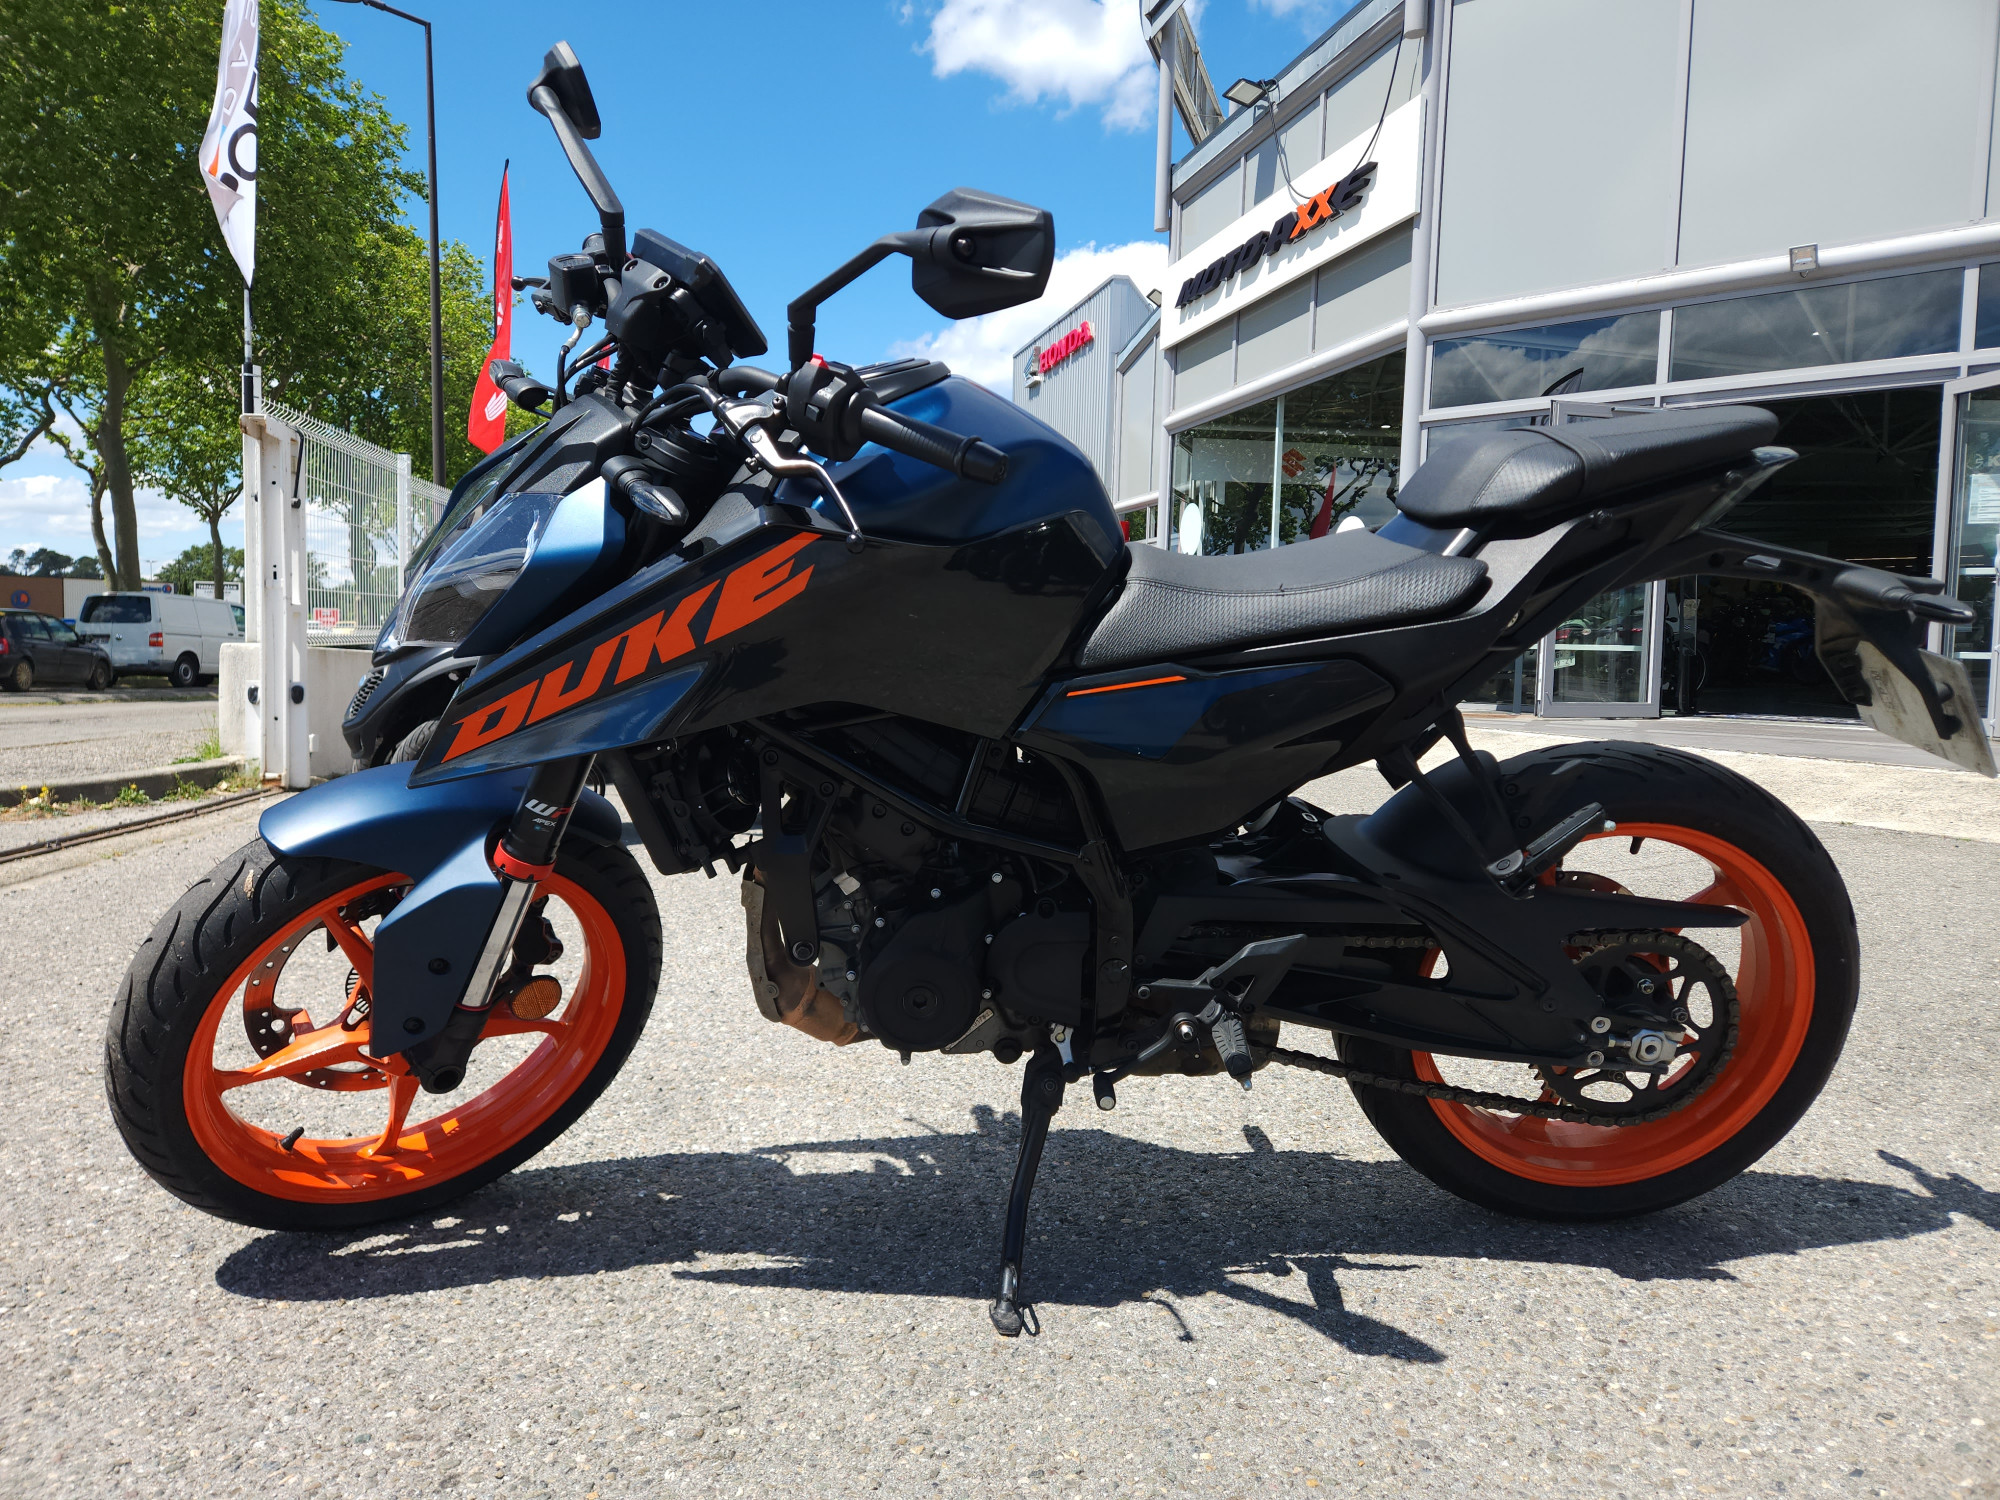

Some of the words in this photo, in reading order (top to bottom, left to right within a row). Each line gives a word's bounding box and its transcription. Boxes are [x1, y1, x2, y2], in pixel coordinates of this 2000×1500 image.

[1038, 320, 1095, 374] HONDA
[441, 531, 823, 764] DUKE
[524, 798, 572, 818] WP
[531, 817, 557, 827] APEX
